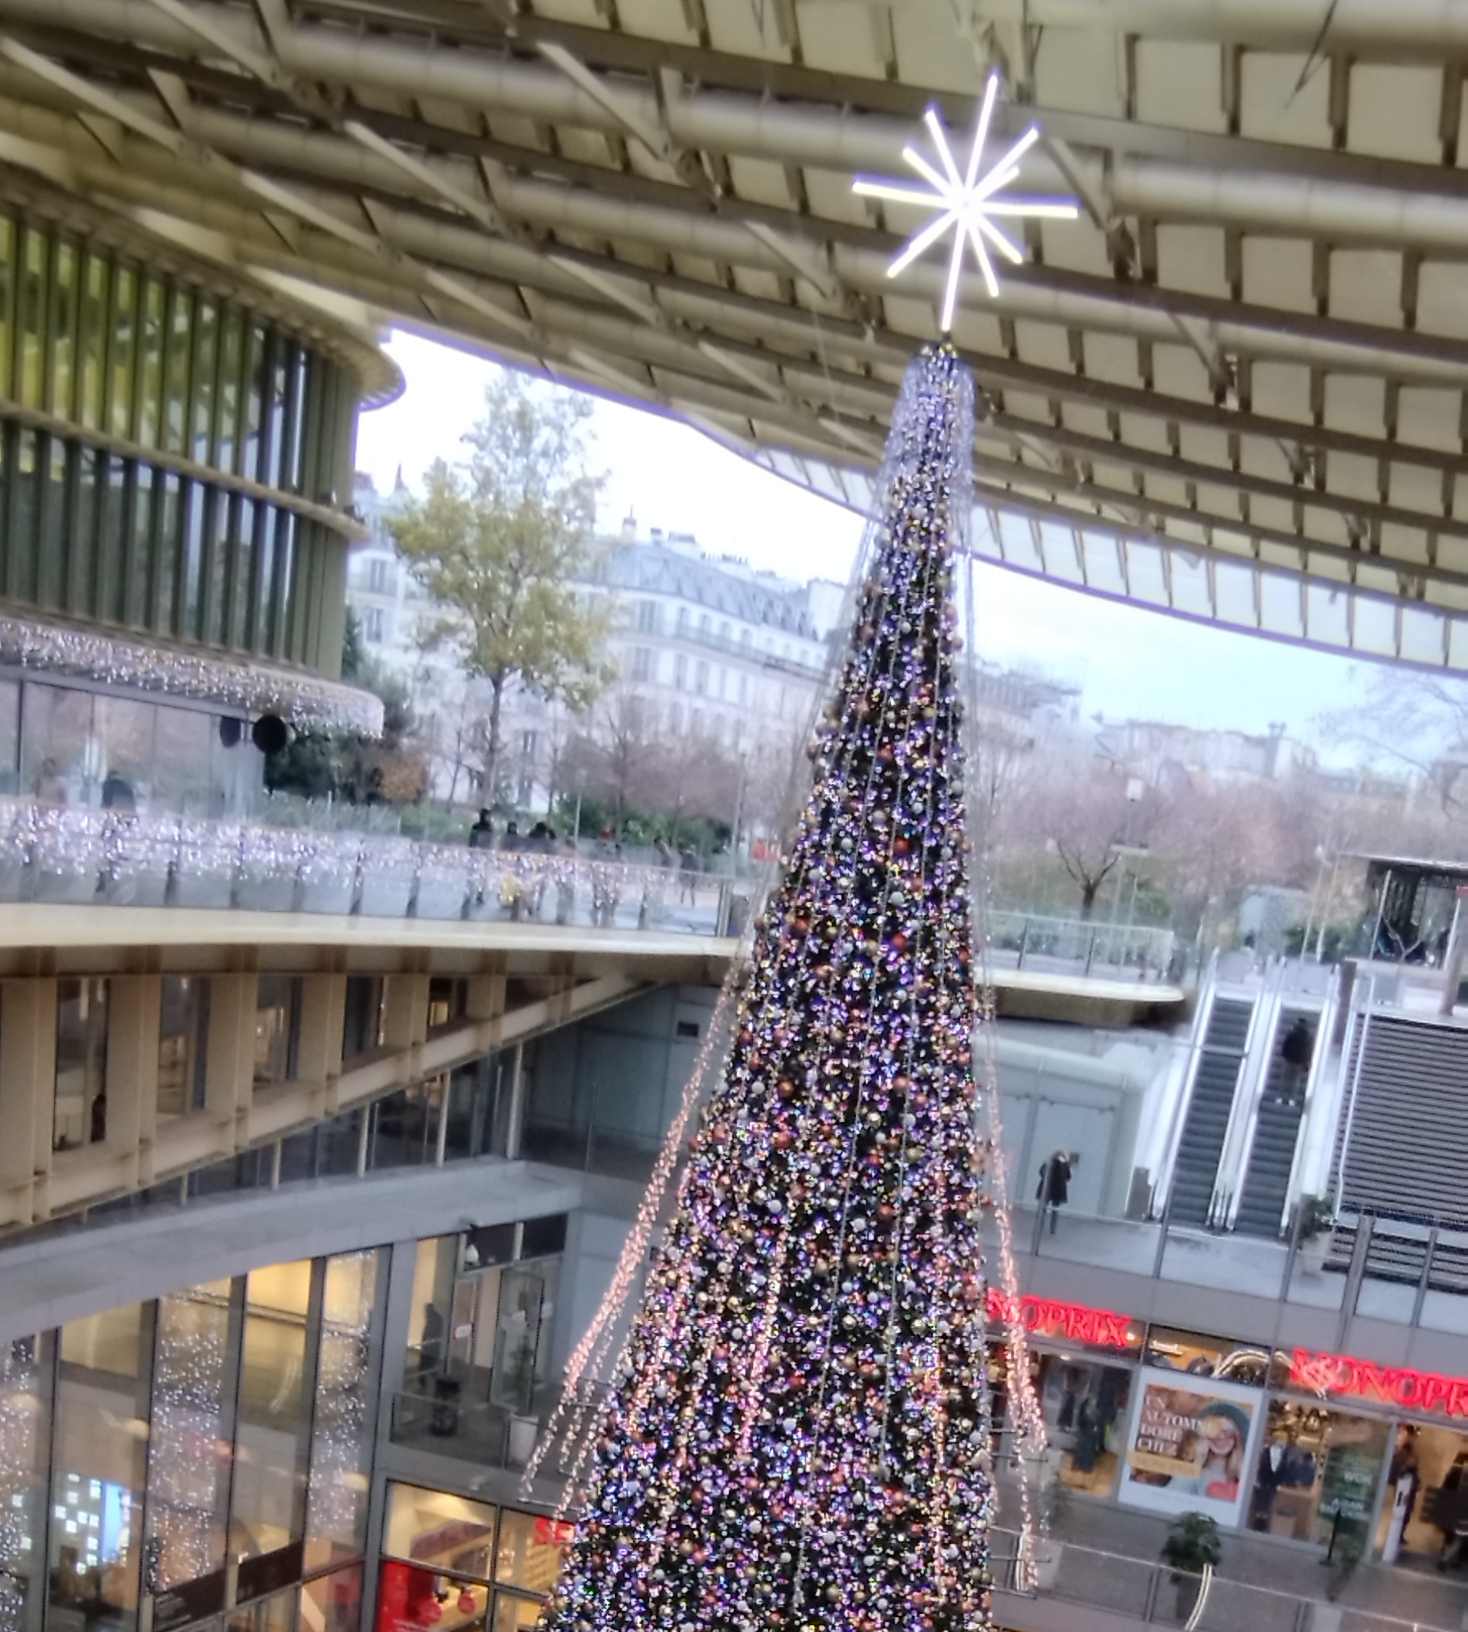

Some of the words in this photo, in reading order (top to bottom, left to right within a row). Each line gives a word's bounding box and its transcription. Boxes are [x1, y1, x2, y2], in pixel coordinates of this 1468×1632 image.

[988, 1287, 1131, 1347] NOPRIX
[1290, 1347, 1468, 1417] MONOPR
[533, 1516, 577, 1547] SF
